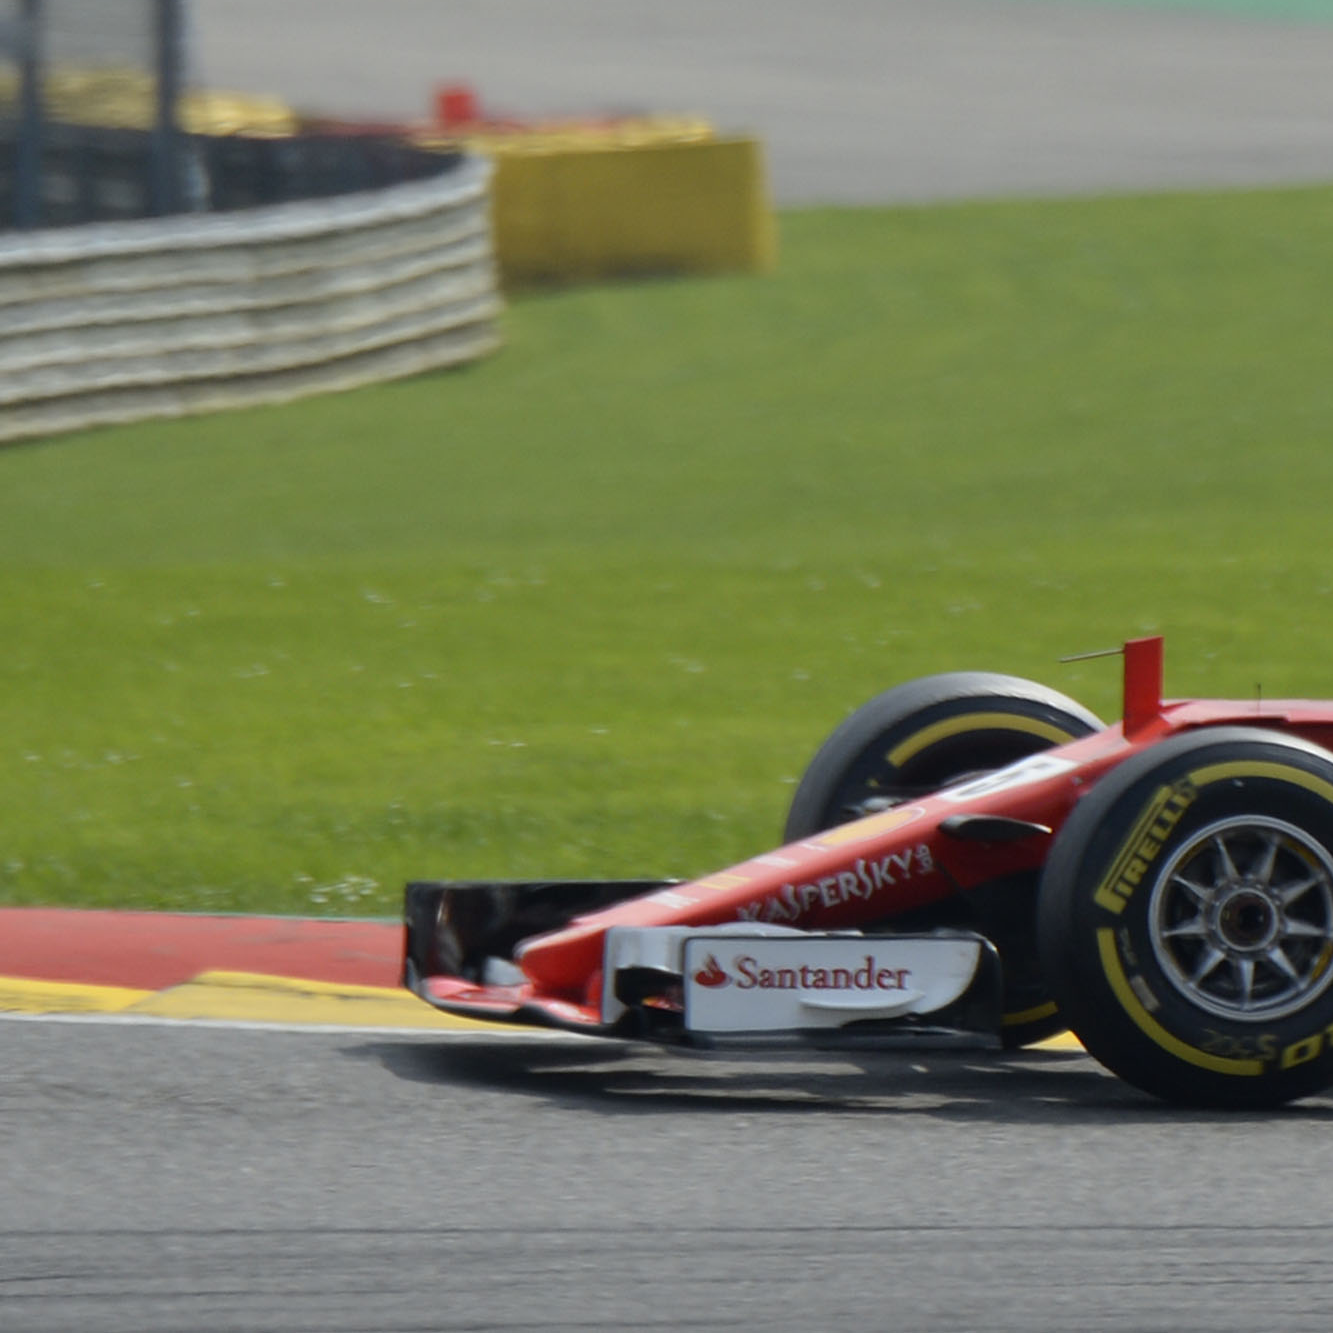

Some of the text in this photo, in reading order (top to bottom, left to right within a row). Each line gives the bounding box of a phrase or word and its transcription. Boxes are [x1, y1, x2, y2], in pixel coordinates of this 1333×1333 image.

[1093, 780, 1198, 914] PIRELLI
[737, 848, 914, 923] KASPERSKY
[737, 956, 910, 992] Santander
